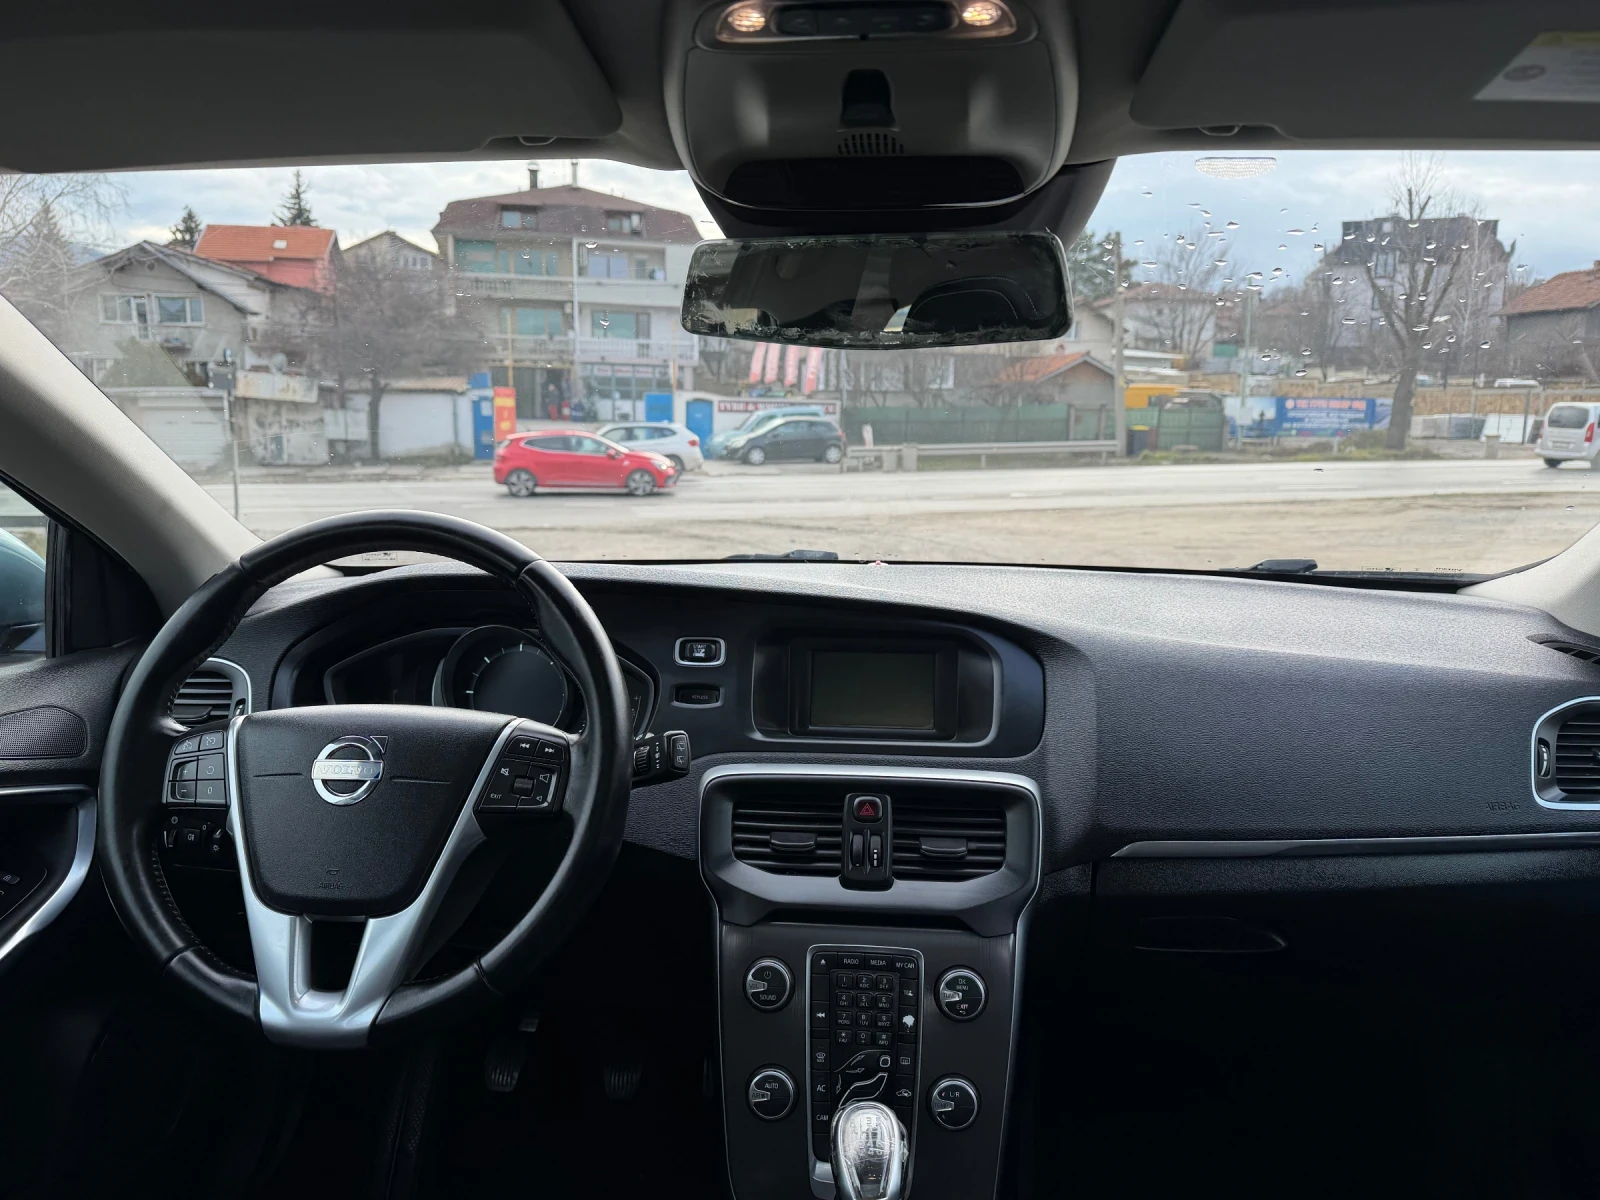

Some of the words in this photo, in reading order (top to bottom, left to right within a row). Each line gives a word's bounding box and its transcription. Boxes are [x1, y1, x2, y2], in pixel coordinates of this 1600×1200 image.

[318, 764, 377, 775] VOLVO
[319, 882, 344, 890] AIRBAG
[816, 1084, 826, 1092] AC
